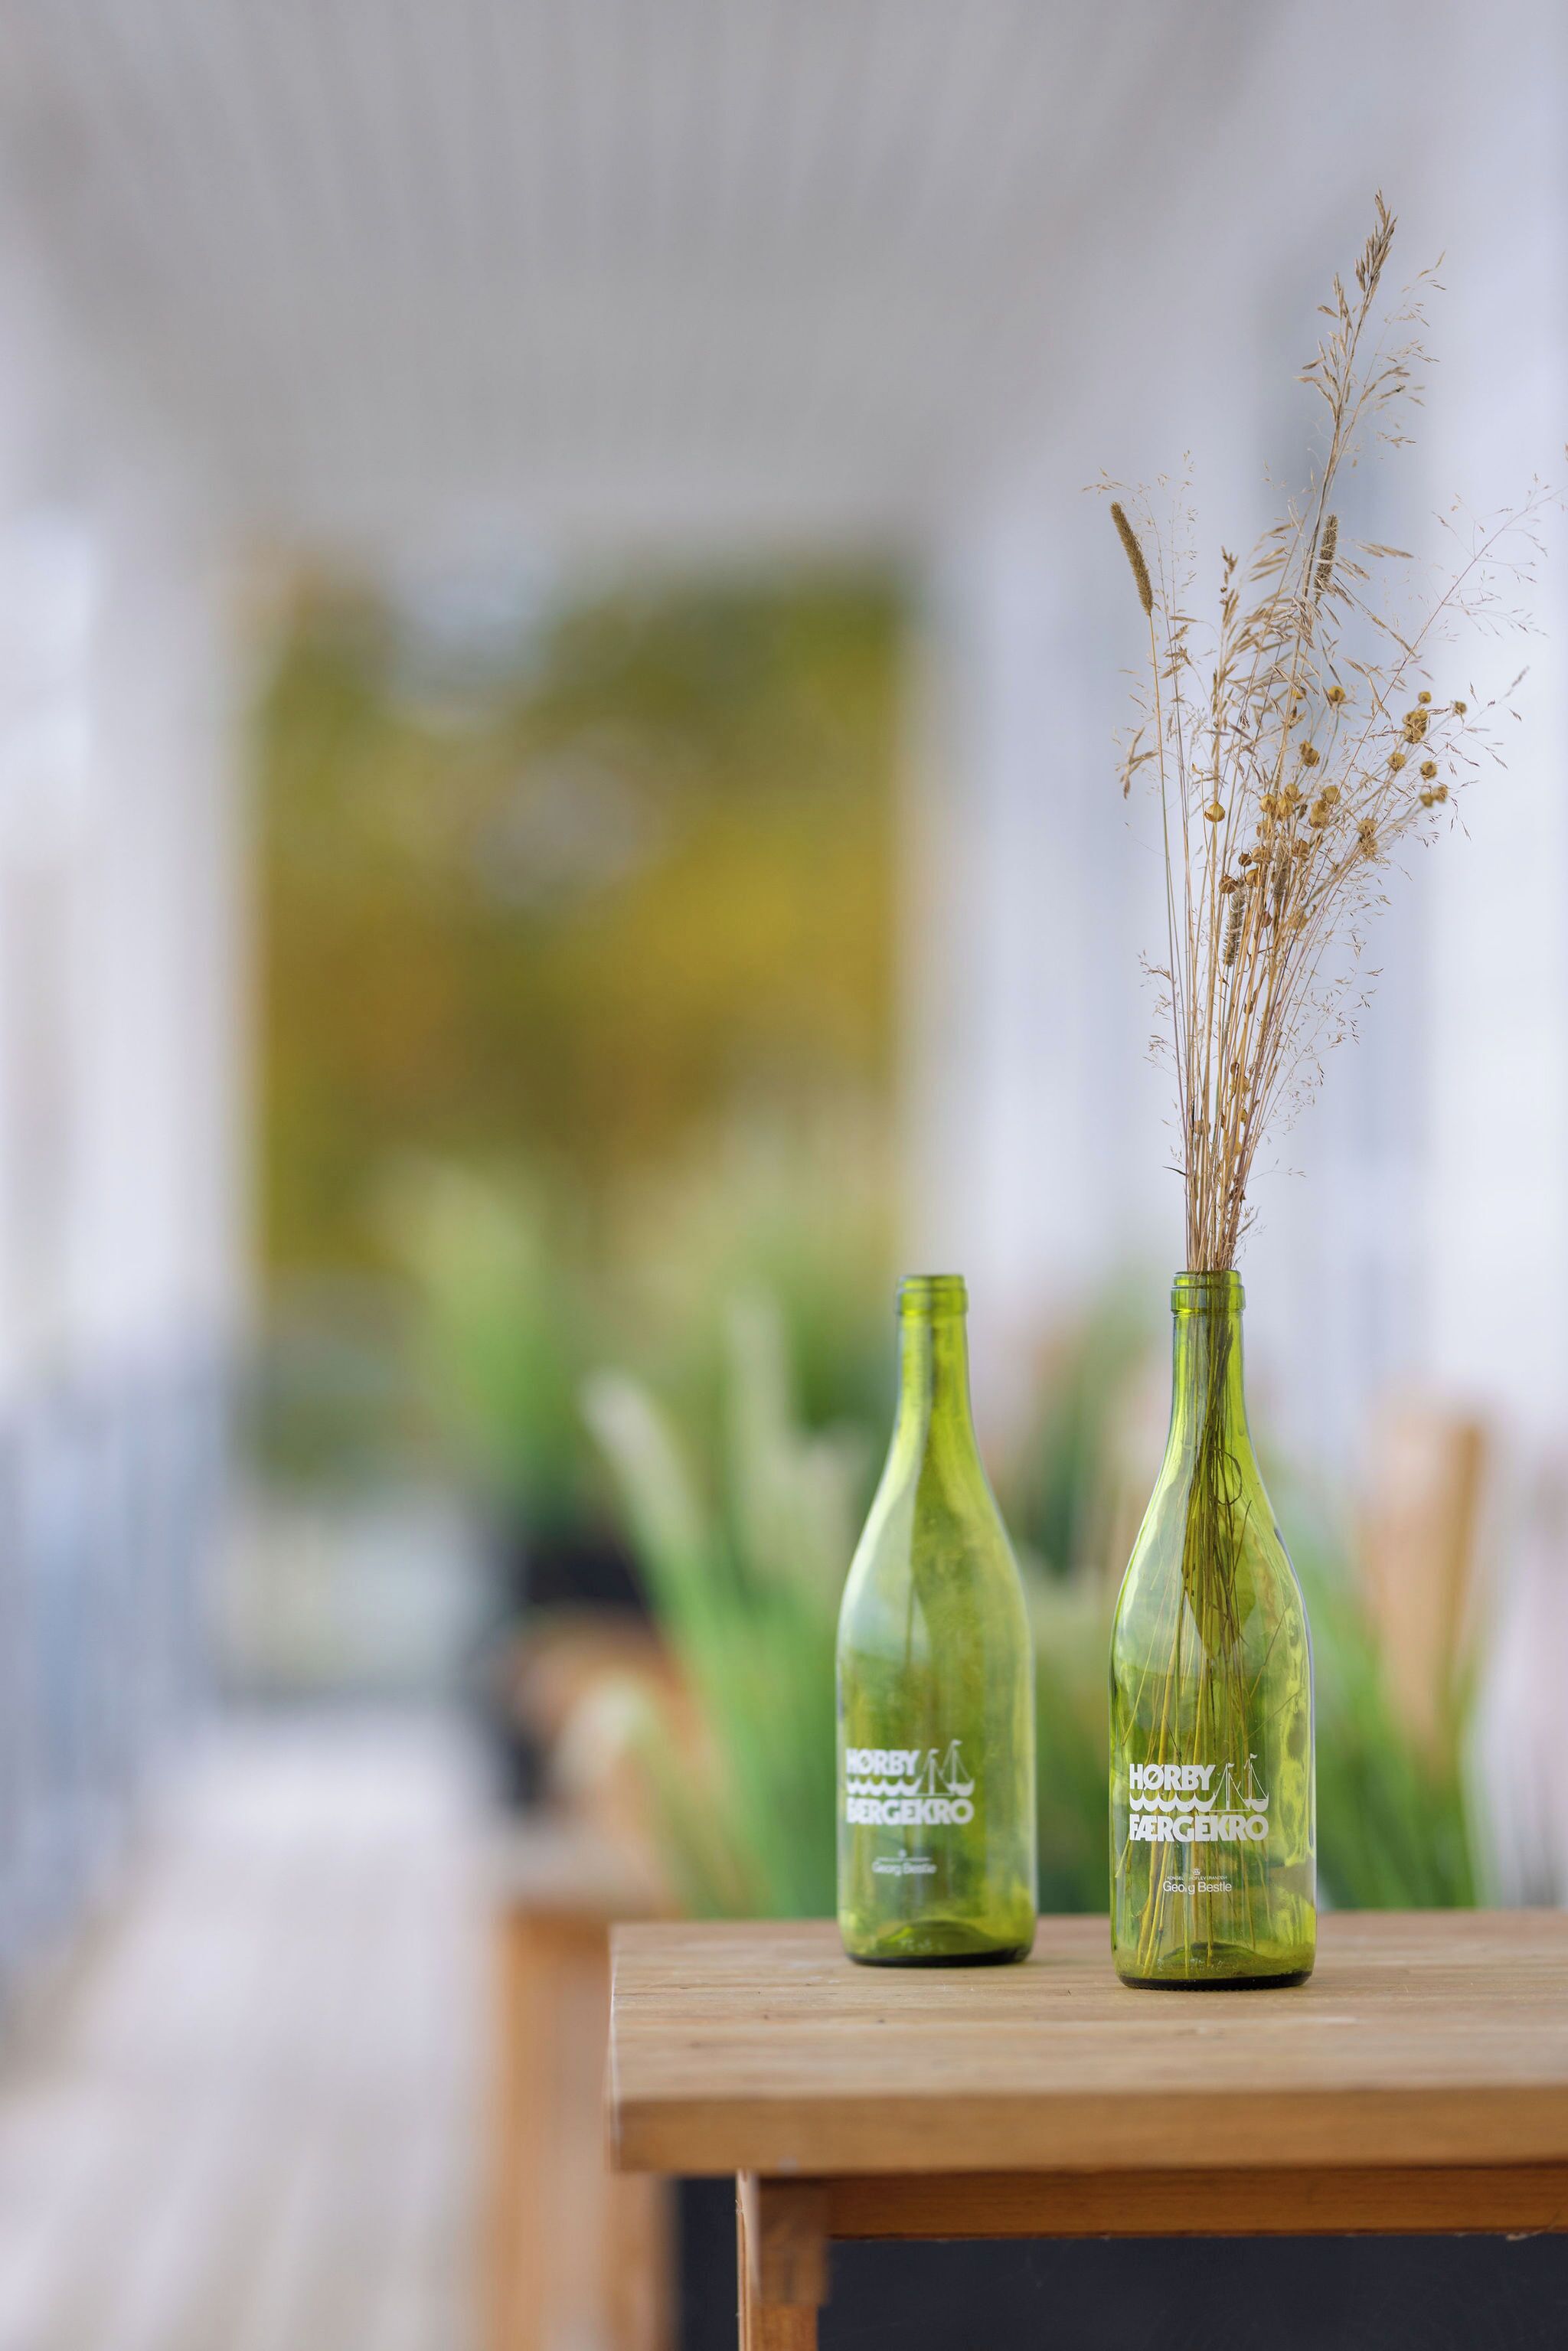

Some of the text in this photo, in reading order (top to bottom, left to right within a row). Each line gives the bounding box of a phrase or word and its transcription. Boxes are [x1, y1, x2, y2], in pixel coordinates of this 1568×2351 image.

[1129, 1763, 1216, 1791] HØRBY
[1129, 1814, 1269, 1842] FÆRGEKRO
[1197, 1881, 1232, 1892] Bestle
